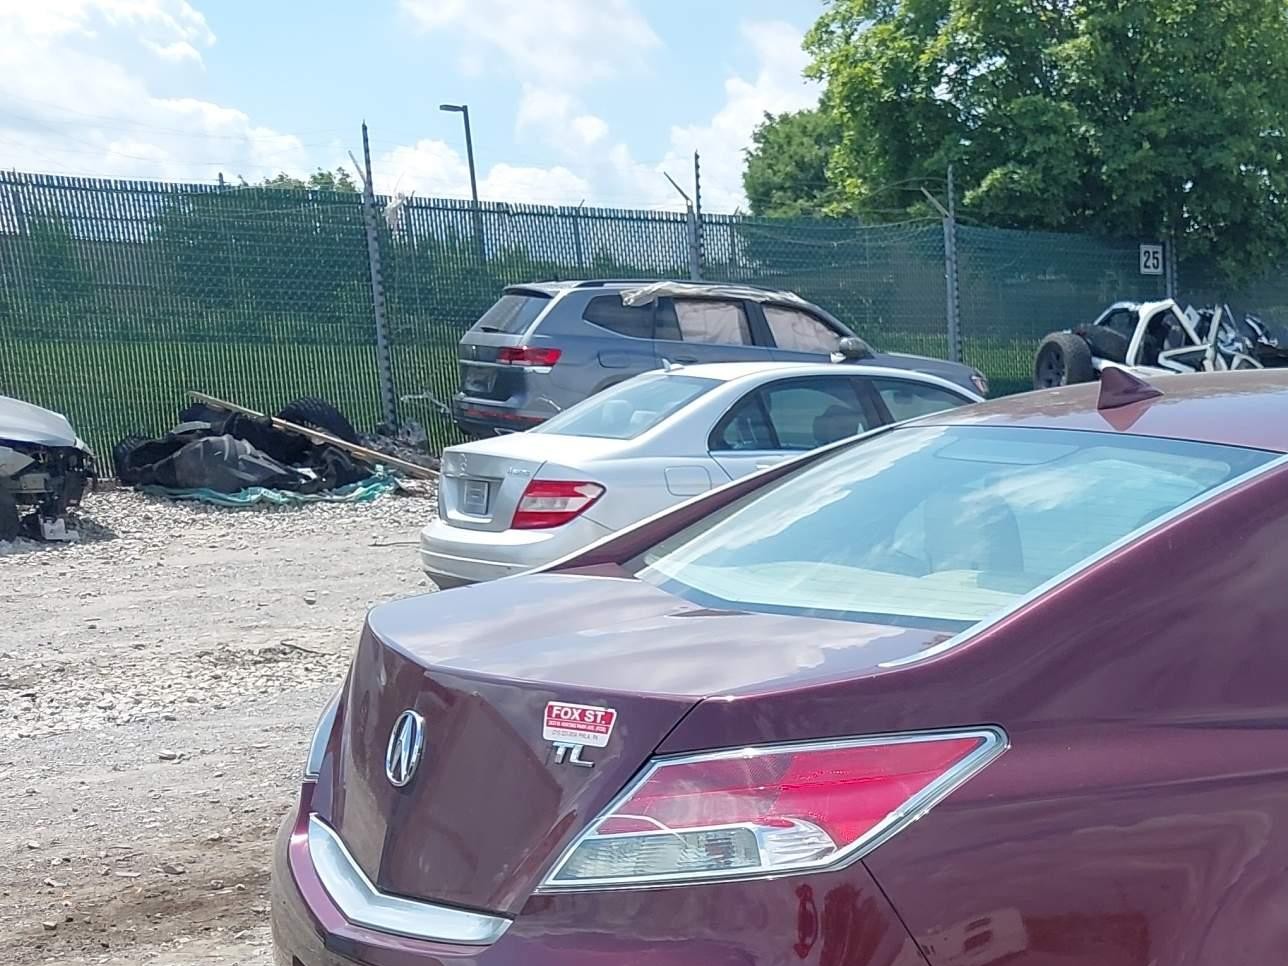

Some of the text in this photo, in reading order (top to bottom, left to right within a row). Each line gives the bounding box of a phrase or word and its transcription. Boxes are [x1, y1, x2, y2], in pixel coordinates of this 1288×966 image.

[1144, 250, 1160, 270] 25
[551, 705, 606, 724] FOX ST.
[552, 741, 595, 768] TL
